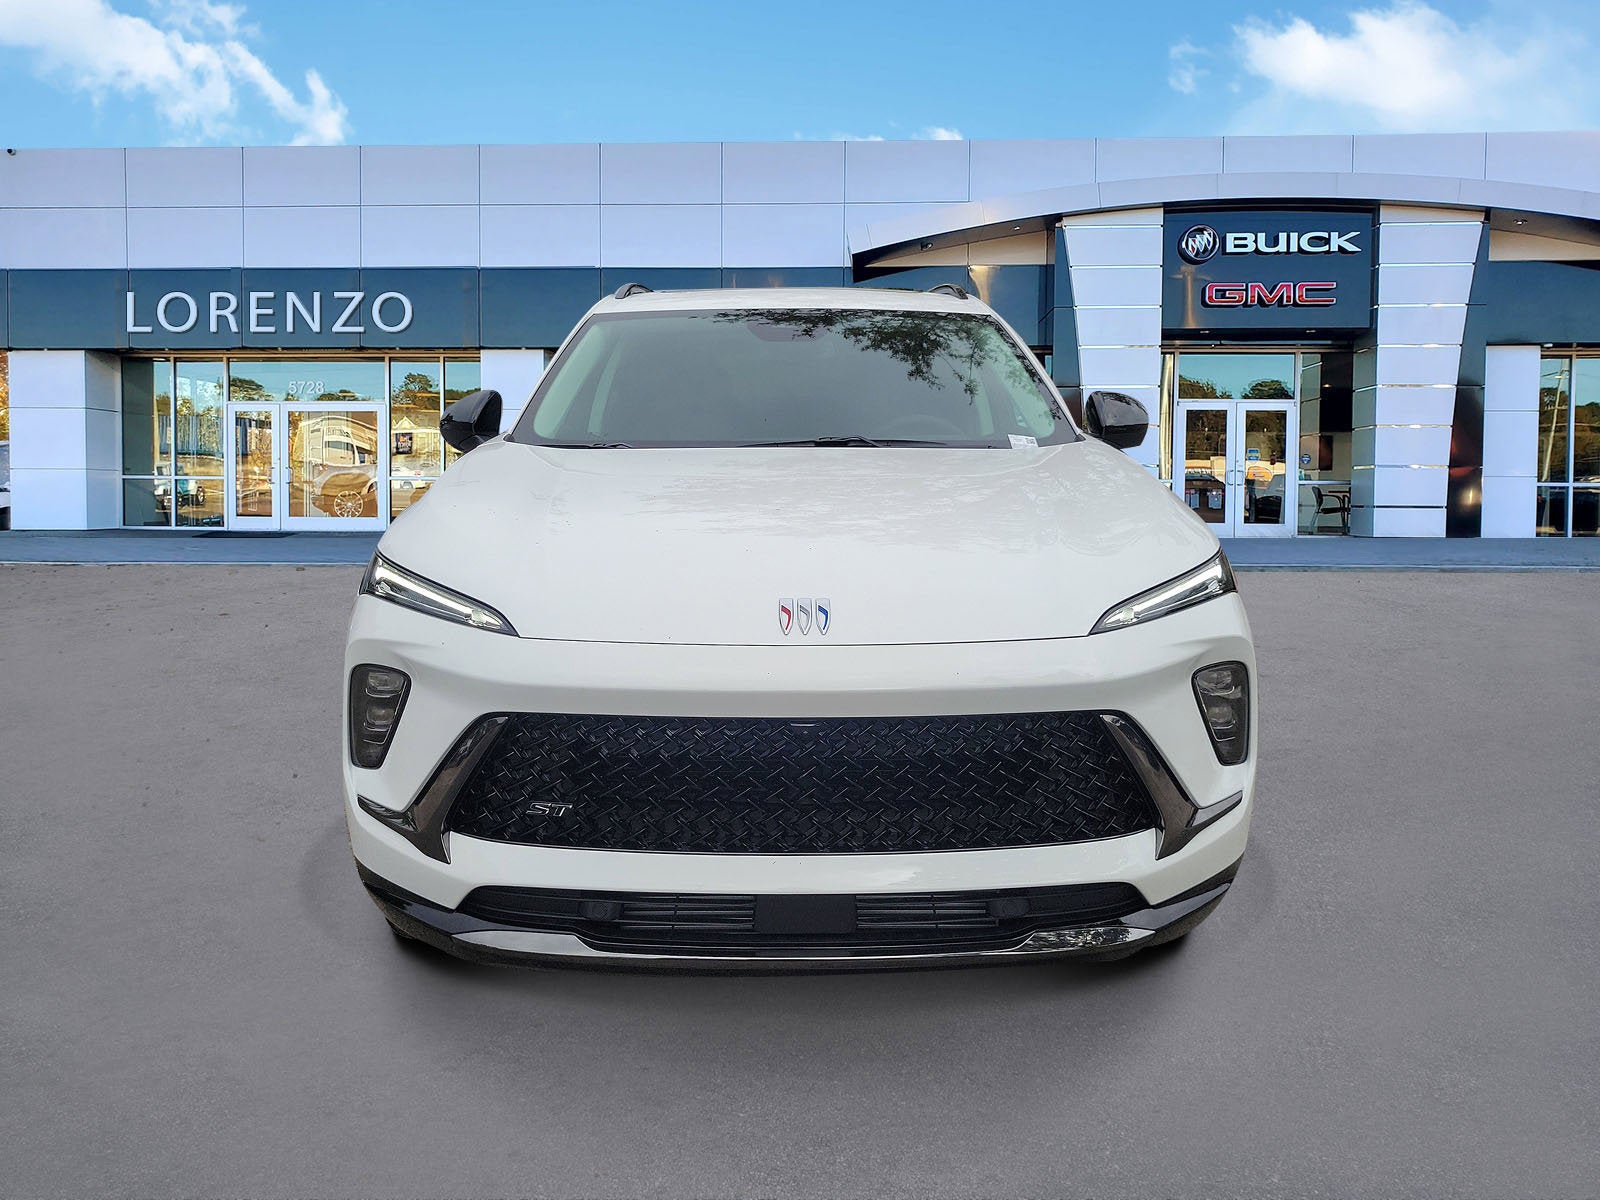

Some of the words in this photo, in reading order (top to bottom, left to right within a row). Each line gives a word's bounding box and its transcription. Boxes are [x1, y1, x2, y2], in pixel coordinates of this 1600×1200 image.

[1225, 231, 1362, 253] BUICK
[1205, 282, 1337, 306] GMC
[126, 291, 414, 333] LORENZO
[288, 380, 325, 394] 5728
[525, 802, 573, 817] ST
